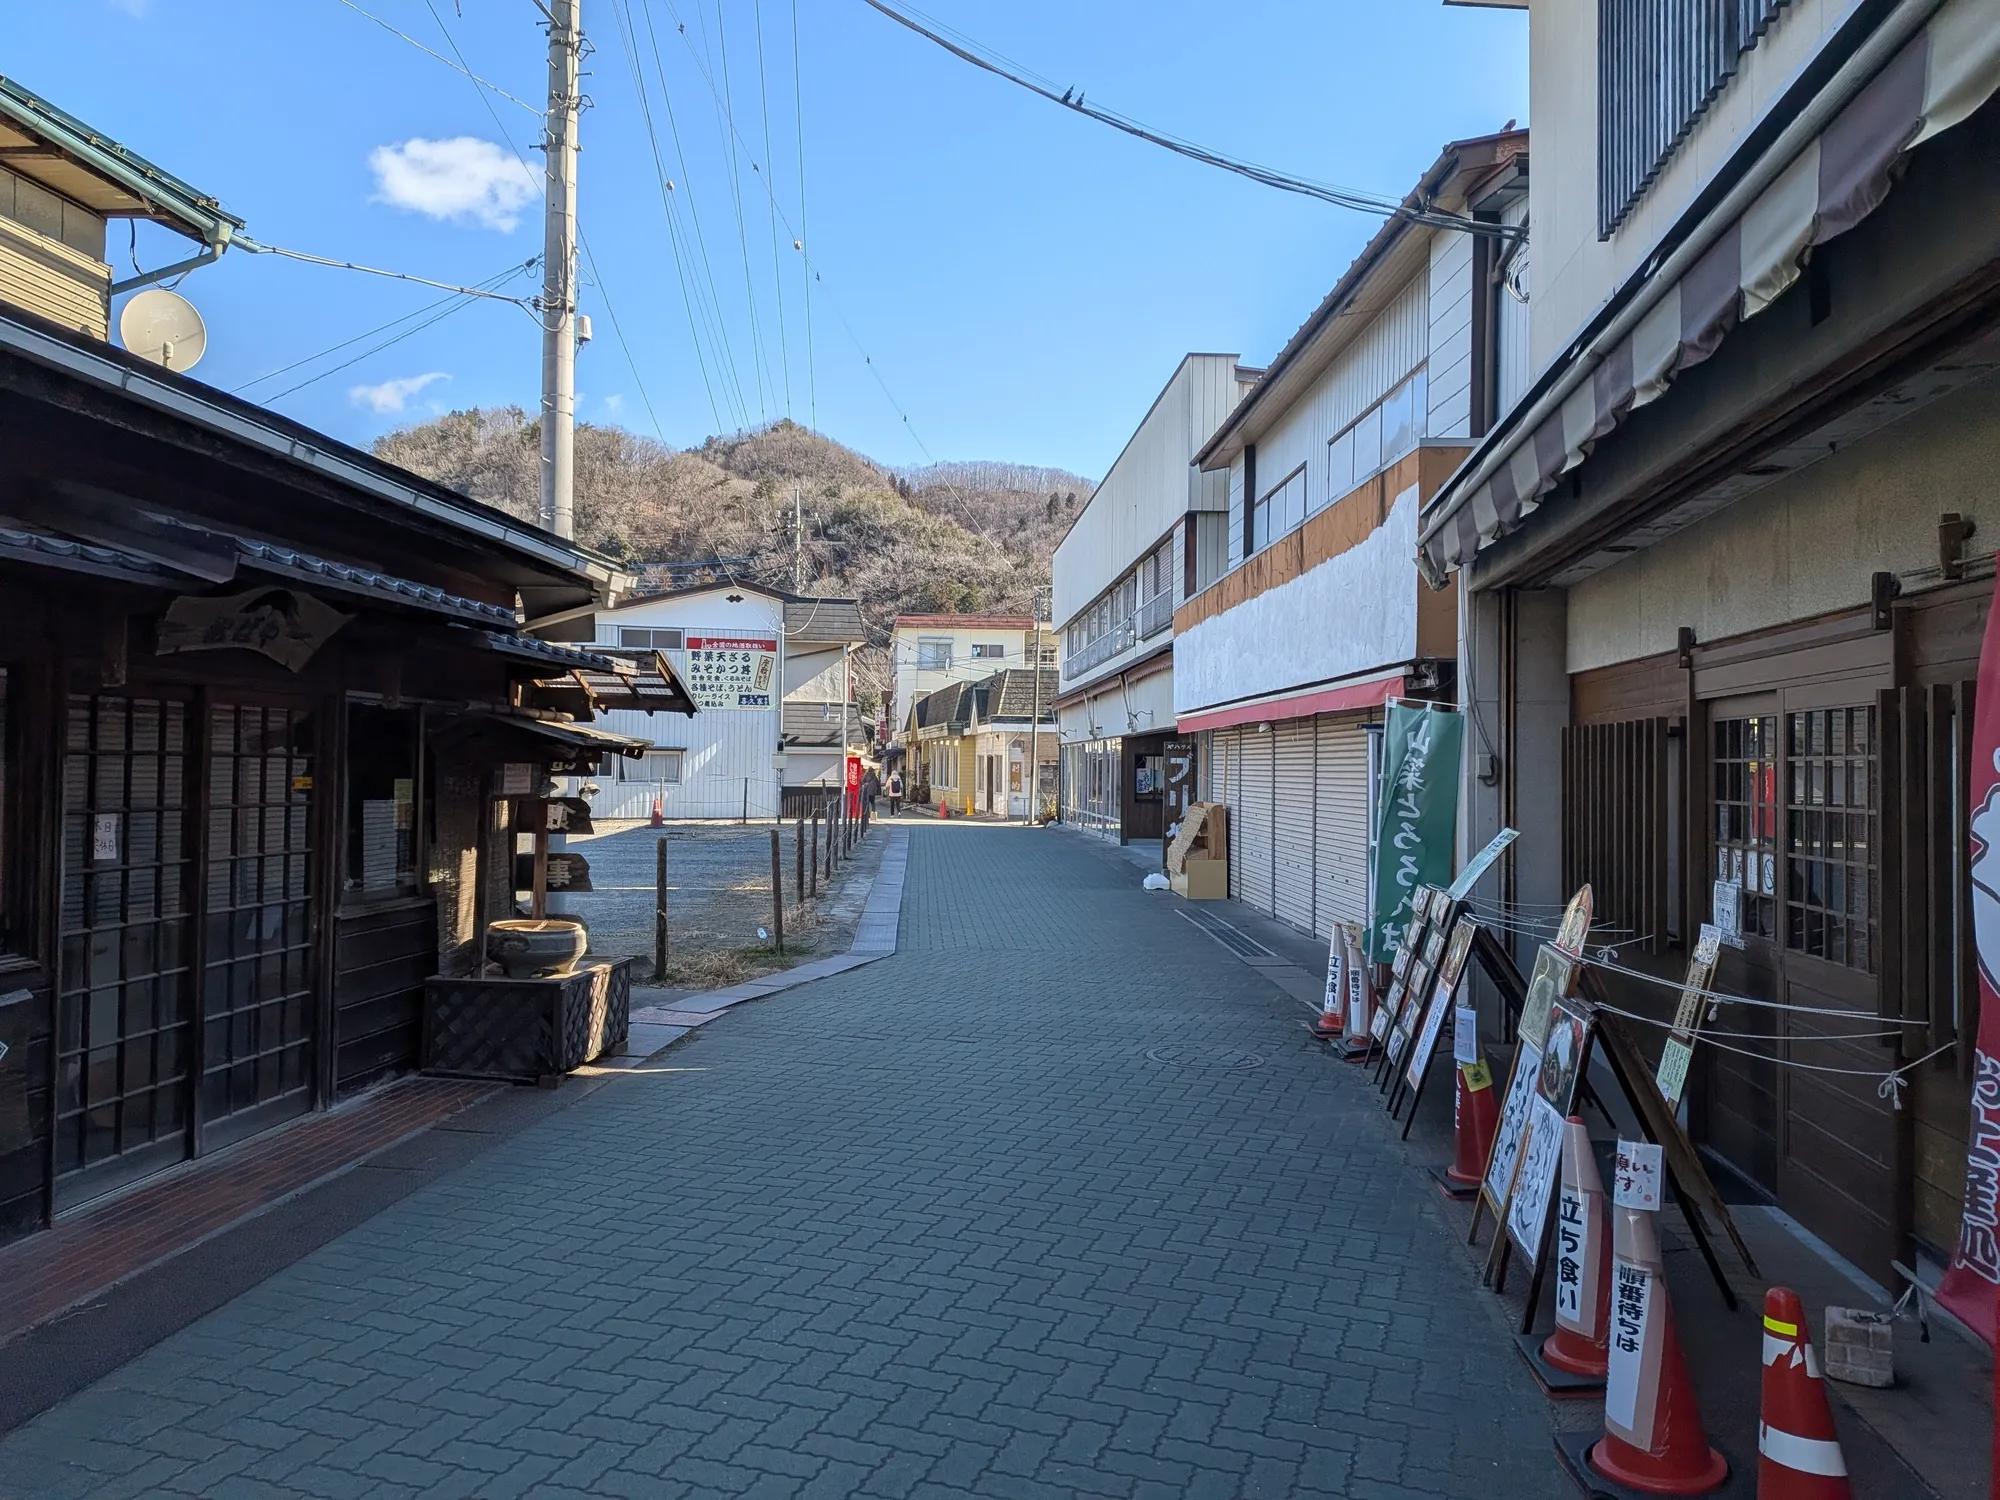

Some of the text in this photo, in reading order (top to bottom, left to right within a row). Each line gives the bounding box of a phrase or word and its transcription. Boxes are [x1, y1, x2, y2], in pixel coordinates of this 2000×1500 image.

[690, 650, 751, 662] 野菜天ざる
[712, 641, 766, 649] 全国の地酒取扱い
[690, 663, 752, 675] みそかつ丼
[690, 683, 753, 693] 各種そば、うどん
[1327, 956, 1340, 1004] 立ち食い
[1350, 969, 1361, 1003] 順番待ちは
[1556, 1196, 1584, 1312] 立ち食い
[1616, 1264, 1649, 1354] 順番待ちは
